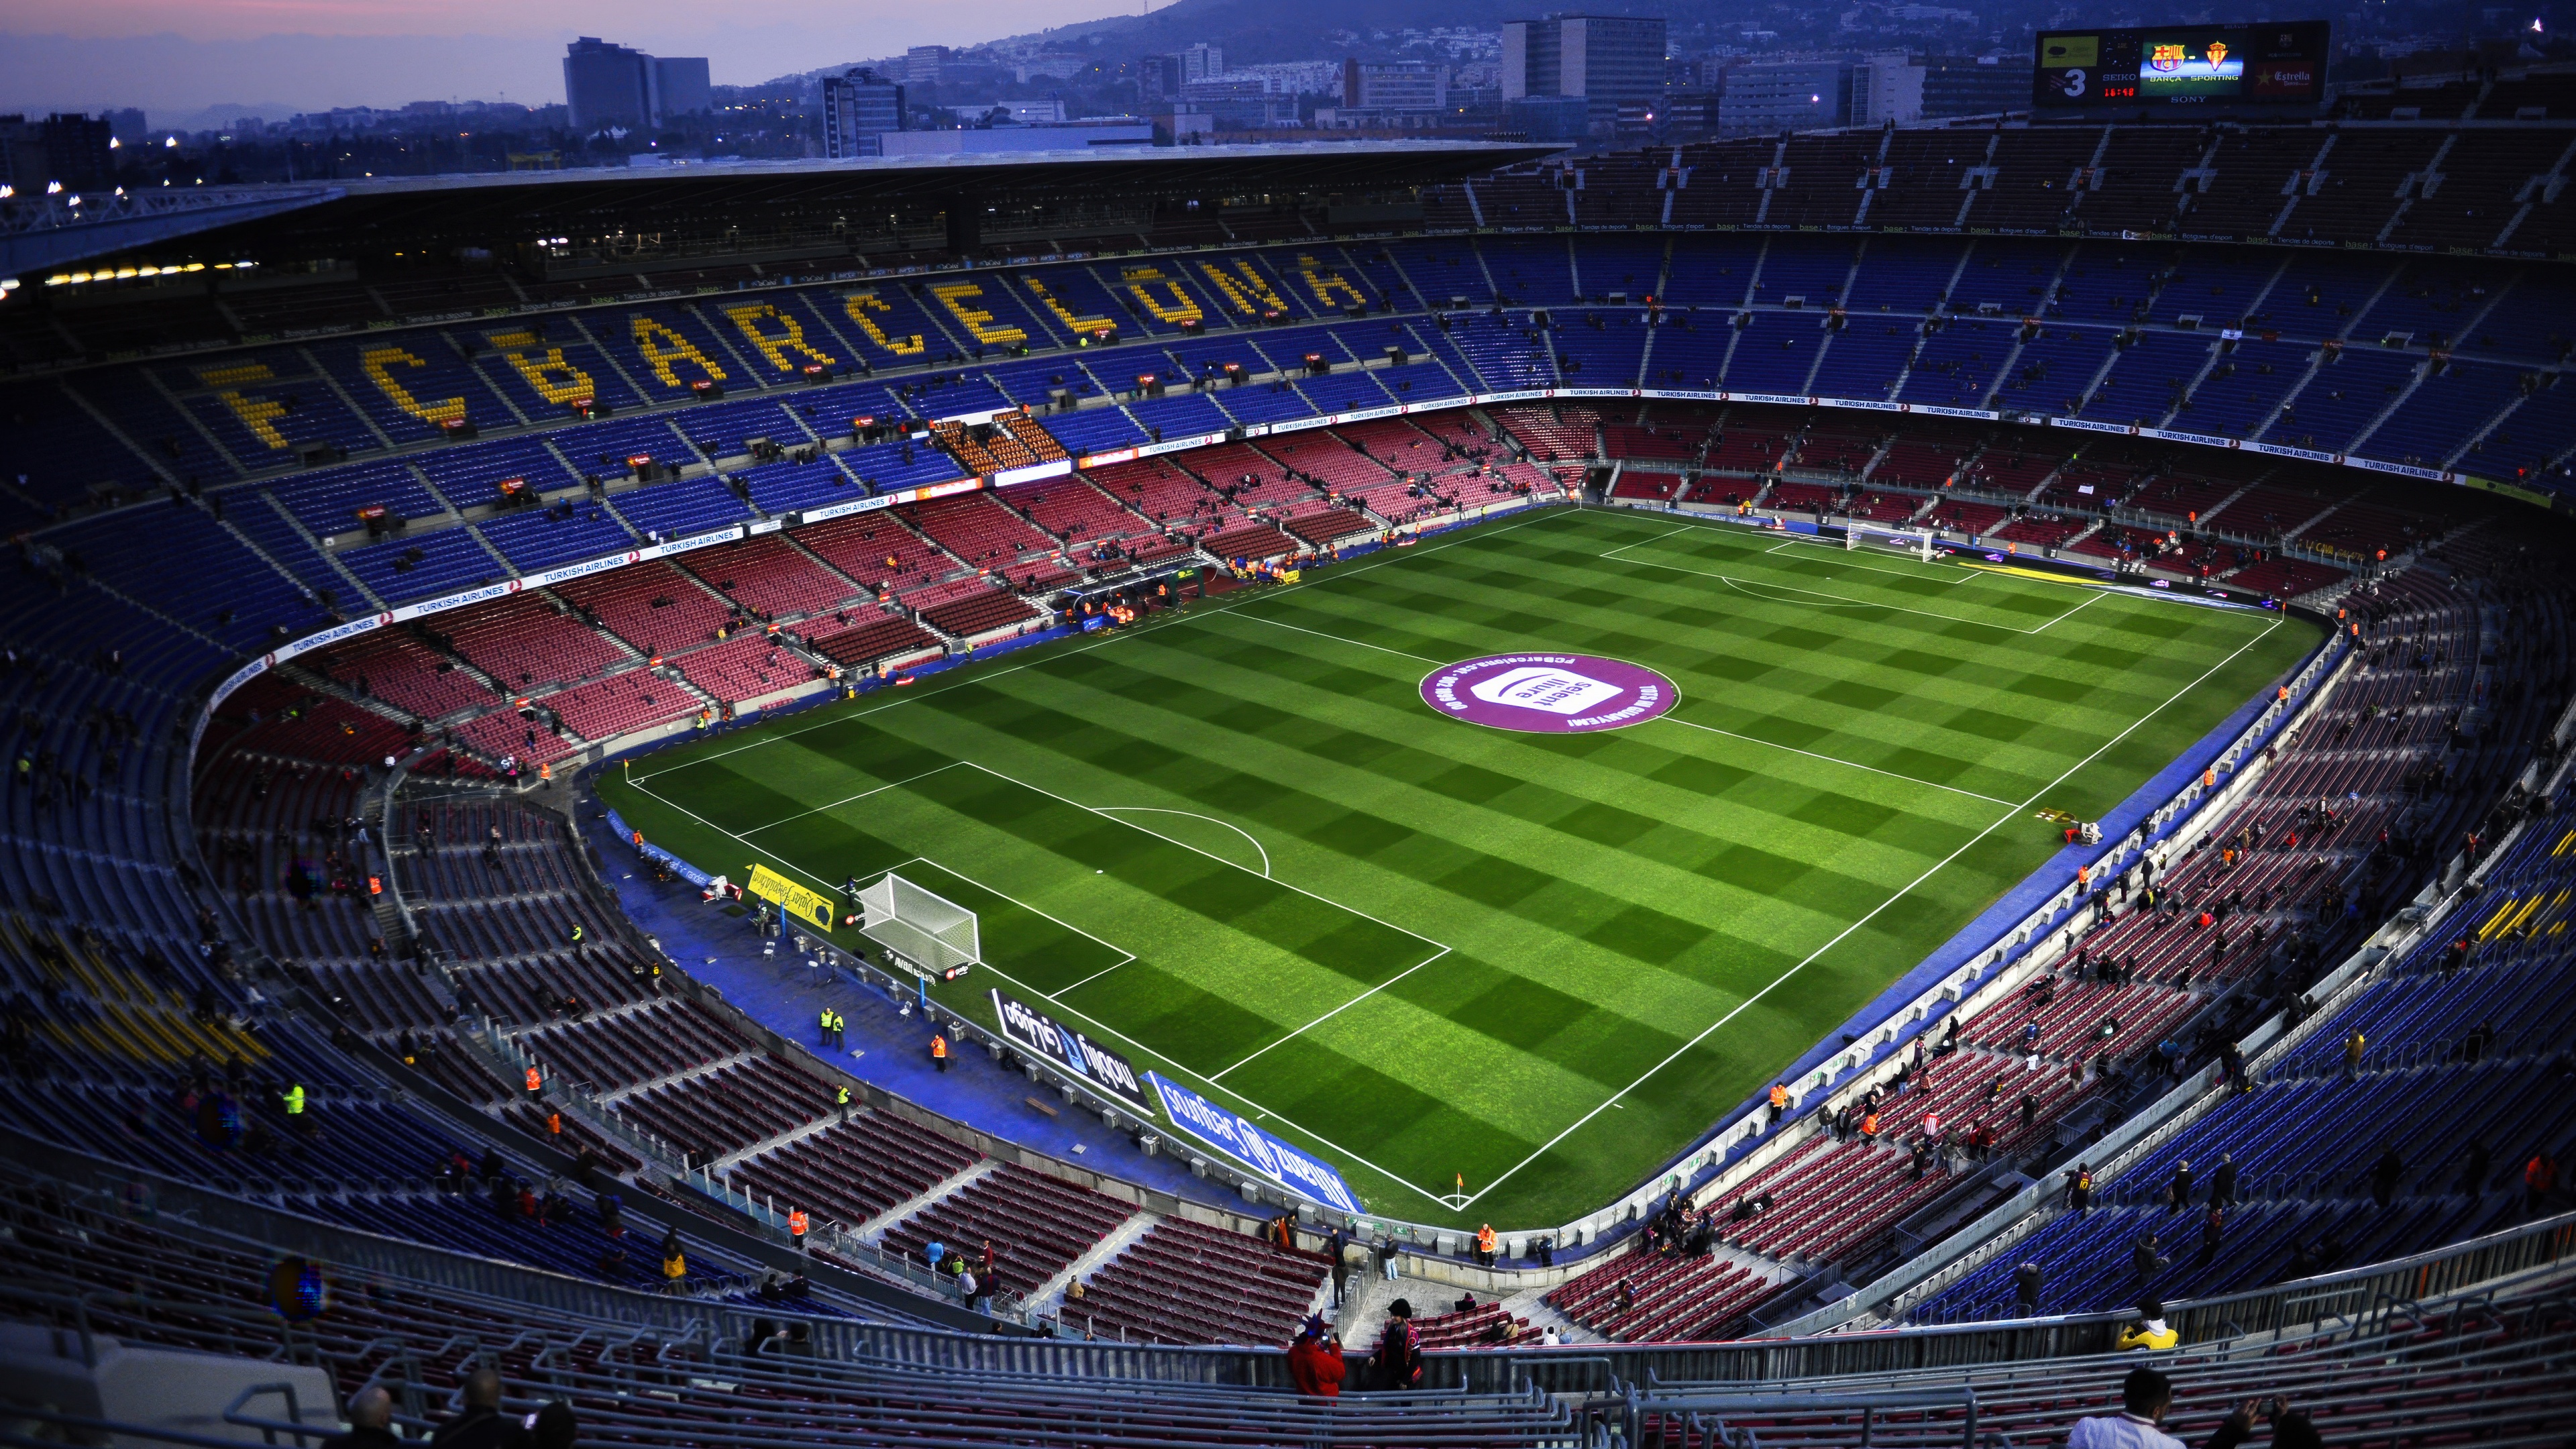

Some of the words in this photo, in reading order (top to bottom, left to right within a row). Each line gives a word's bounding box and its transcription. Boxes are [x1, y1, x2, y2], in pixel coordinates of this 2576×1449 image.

[2064, 68, 2086, 97] 3
[2275, 71, 2310, 80] Estrella
[2151, 231, 2176, 239] base:
[2247, 235, 2273, 244] base:
[2345, 240, 2373, 249] base:
[2449, 246, 2477, 255] base:
[488, 254, 1367, 406] BARCELONA
[1490, 393, 1515, 401] TURKISH
[1515, 390, 1542, 398] AIRLINES
[1745, 394, 1774, 402] TURKISH
[1775, 395, 1805, 404] AIRLINES
[1421, 401, 1444, 409] TURKISH
[1444, 398, 1467, 407] AIRLINES
[1835, 399, 1864, 408] TURKISH
[1866, 401, 1897, 410] AIRLINES
[1350, 410, 1373, 420] TURKISH
[1374, 407, 1399, 417] AIRLINES
[1927, 406, 1957, 415] TURKISH
[1959, 408, 1990, 418] AIRLINES
[1278, 421, 1302, 431] TURKISH
[1303, 417, 1327, 428] AIRLINES
[2059, 419, 2091, 429] TURKISH
[2092, 422, 2125, 433] AIRLINES
[2157, 430, 2190, 441] TURKISH
[2191, 434, 2225, 445] AIRLINES
[1149, 441, 1174, 453] TURKISH
[1175, 438, 1202, 449] AIRLINES
[2259, 444, 2293, 456] TURKISH
[2294, 449, 2329, 461] AIRLINES
[2364, 460, 2400, 473] TURKISH
[2401, 466, 2438, 478] AIRLINES
[820, 506, 851, 519] TURKISH
[852, 497, 885, 512] AIRLINES
[660, 540, 696, 553] TURKISH
[698, 531, 734, 545] AIRLINES
[544, 566, 584, 582] TURKISH
[585, 555, 624, 572] AIRLINES
[417, 596, 460, 613] TURKISH
[462, 586, 504, 603] AIRLINES
[1453, 657, 1576, 674] FCBarcelona.cat
[1436, 676, 1458, 687] 902
[1515, 678, 1570, 698] lliure
[1533, 682, 1592, 706] seient
[1640, 685, 1658, 700] TOTS
[1446, 701, 1468, 710] 00
[752, 871, 794, 906] Foundation
[791, 892, 814, 917] Qatar
[1077, 1034, 1138, 1093] mobily
[1163, 1085, 1249, 1158] Seguros
[1267, 1140, 1350, 1212] Allianz
[2080, 1180, 2089, 1189] 10
